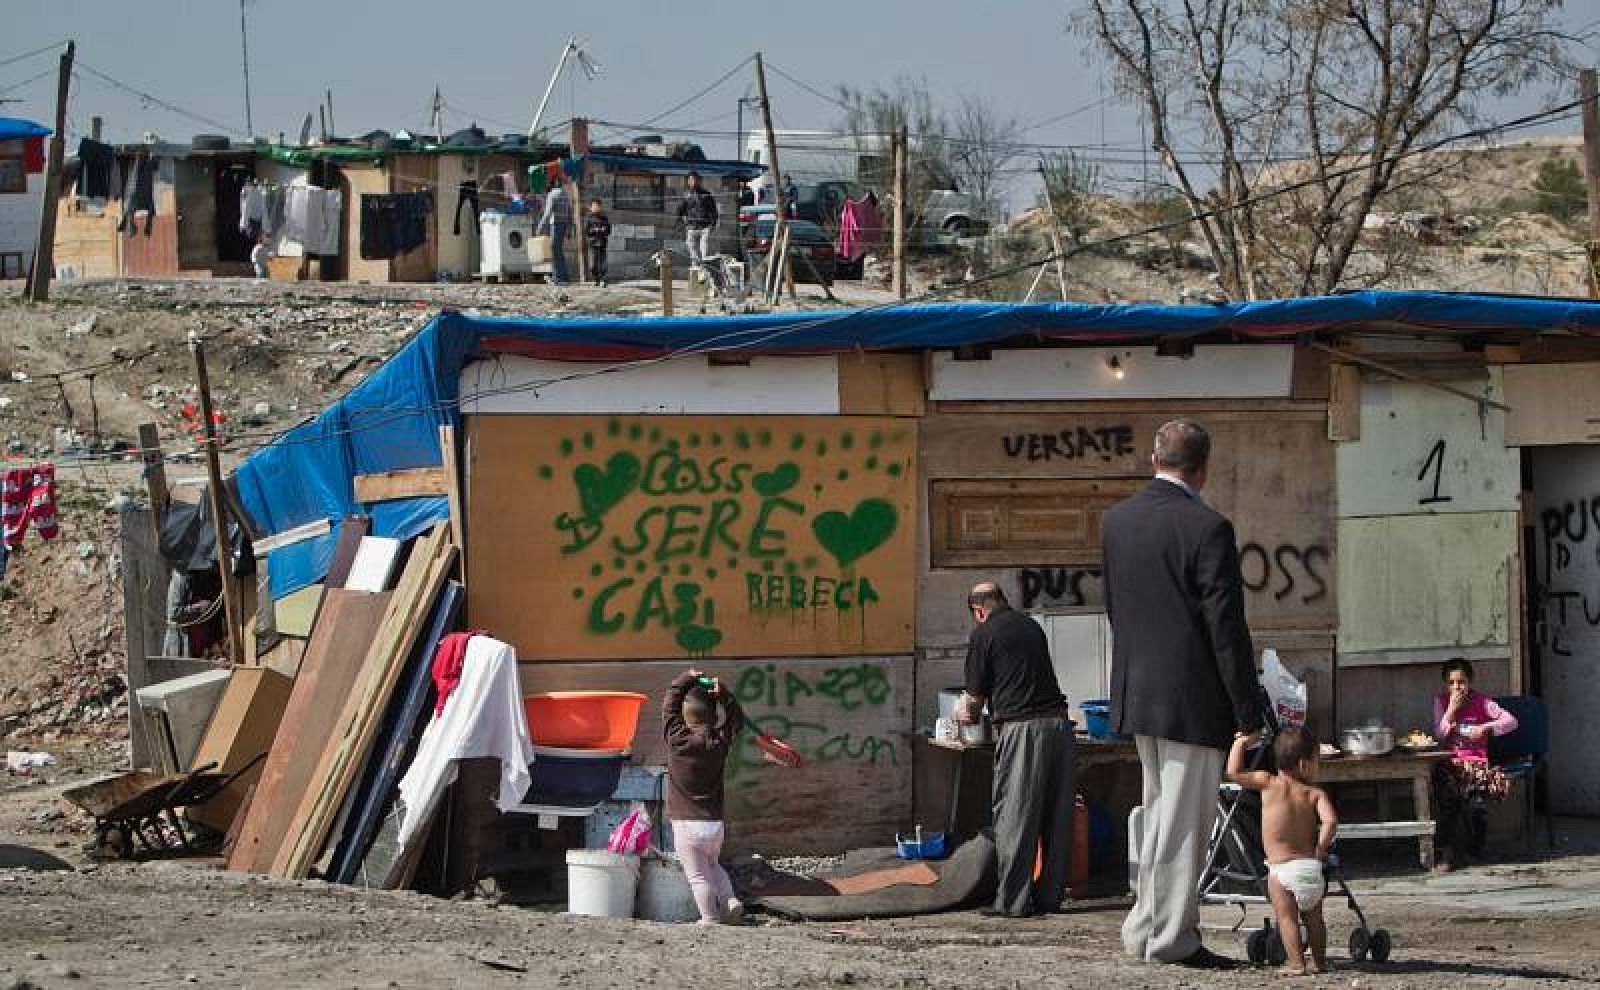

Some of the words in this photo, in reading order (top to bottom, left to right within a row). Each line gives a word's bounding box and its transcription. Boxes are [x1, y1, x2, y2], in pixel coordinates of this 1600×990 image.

[1417, 439, 1453, 505] 1
[612, 498, 805, 562] SERE
[745, 572, 880, 609] REBECA
[1021, 569, 1104, 609] PUS
[1238, 542, 1333, 604] OSS
